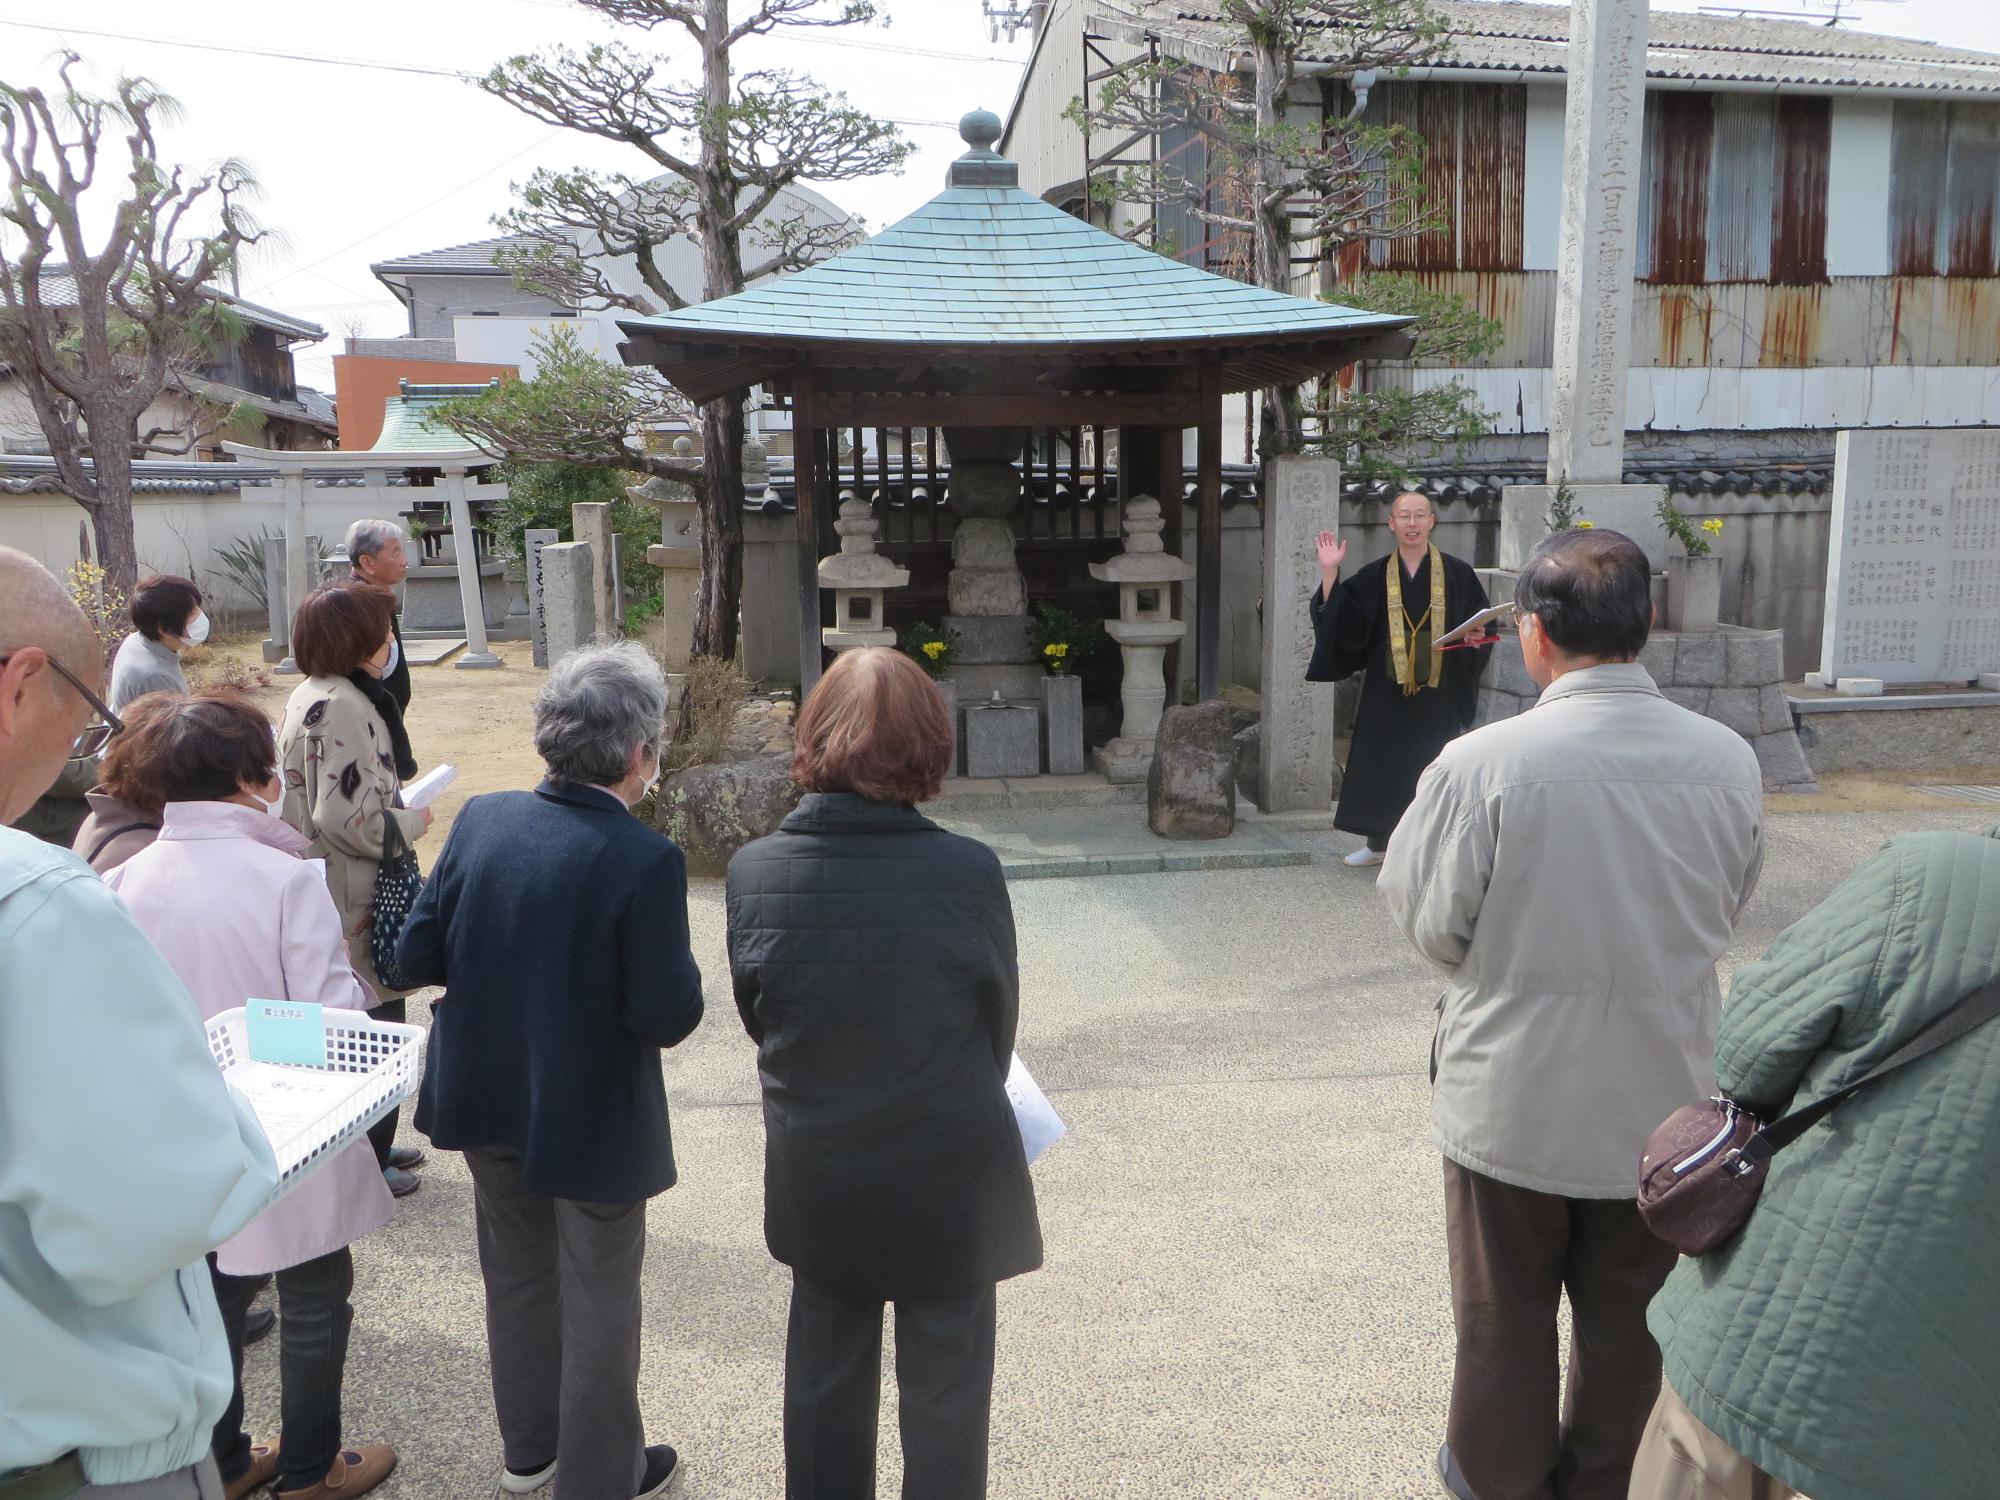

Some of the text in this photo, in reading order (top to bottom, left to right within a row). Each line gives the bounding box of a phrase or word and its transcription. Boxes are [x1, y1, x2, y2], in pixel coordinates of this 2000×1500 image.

[264, 1007, 304, 1019] 郷土を学ぶ
